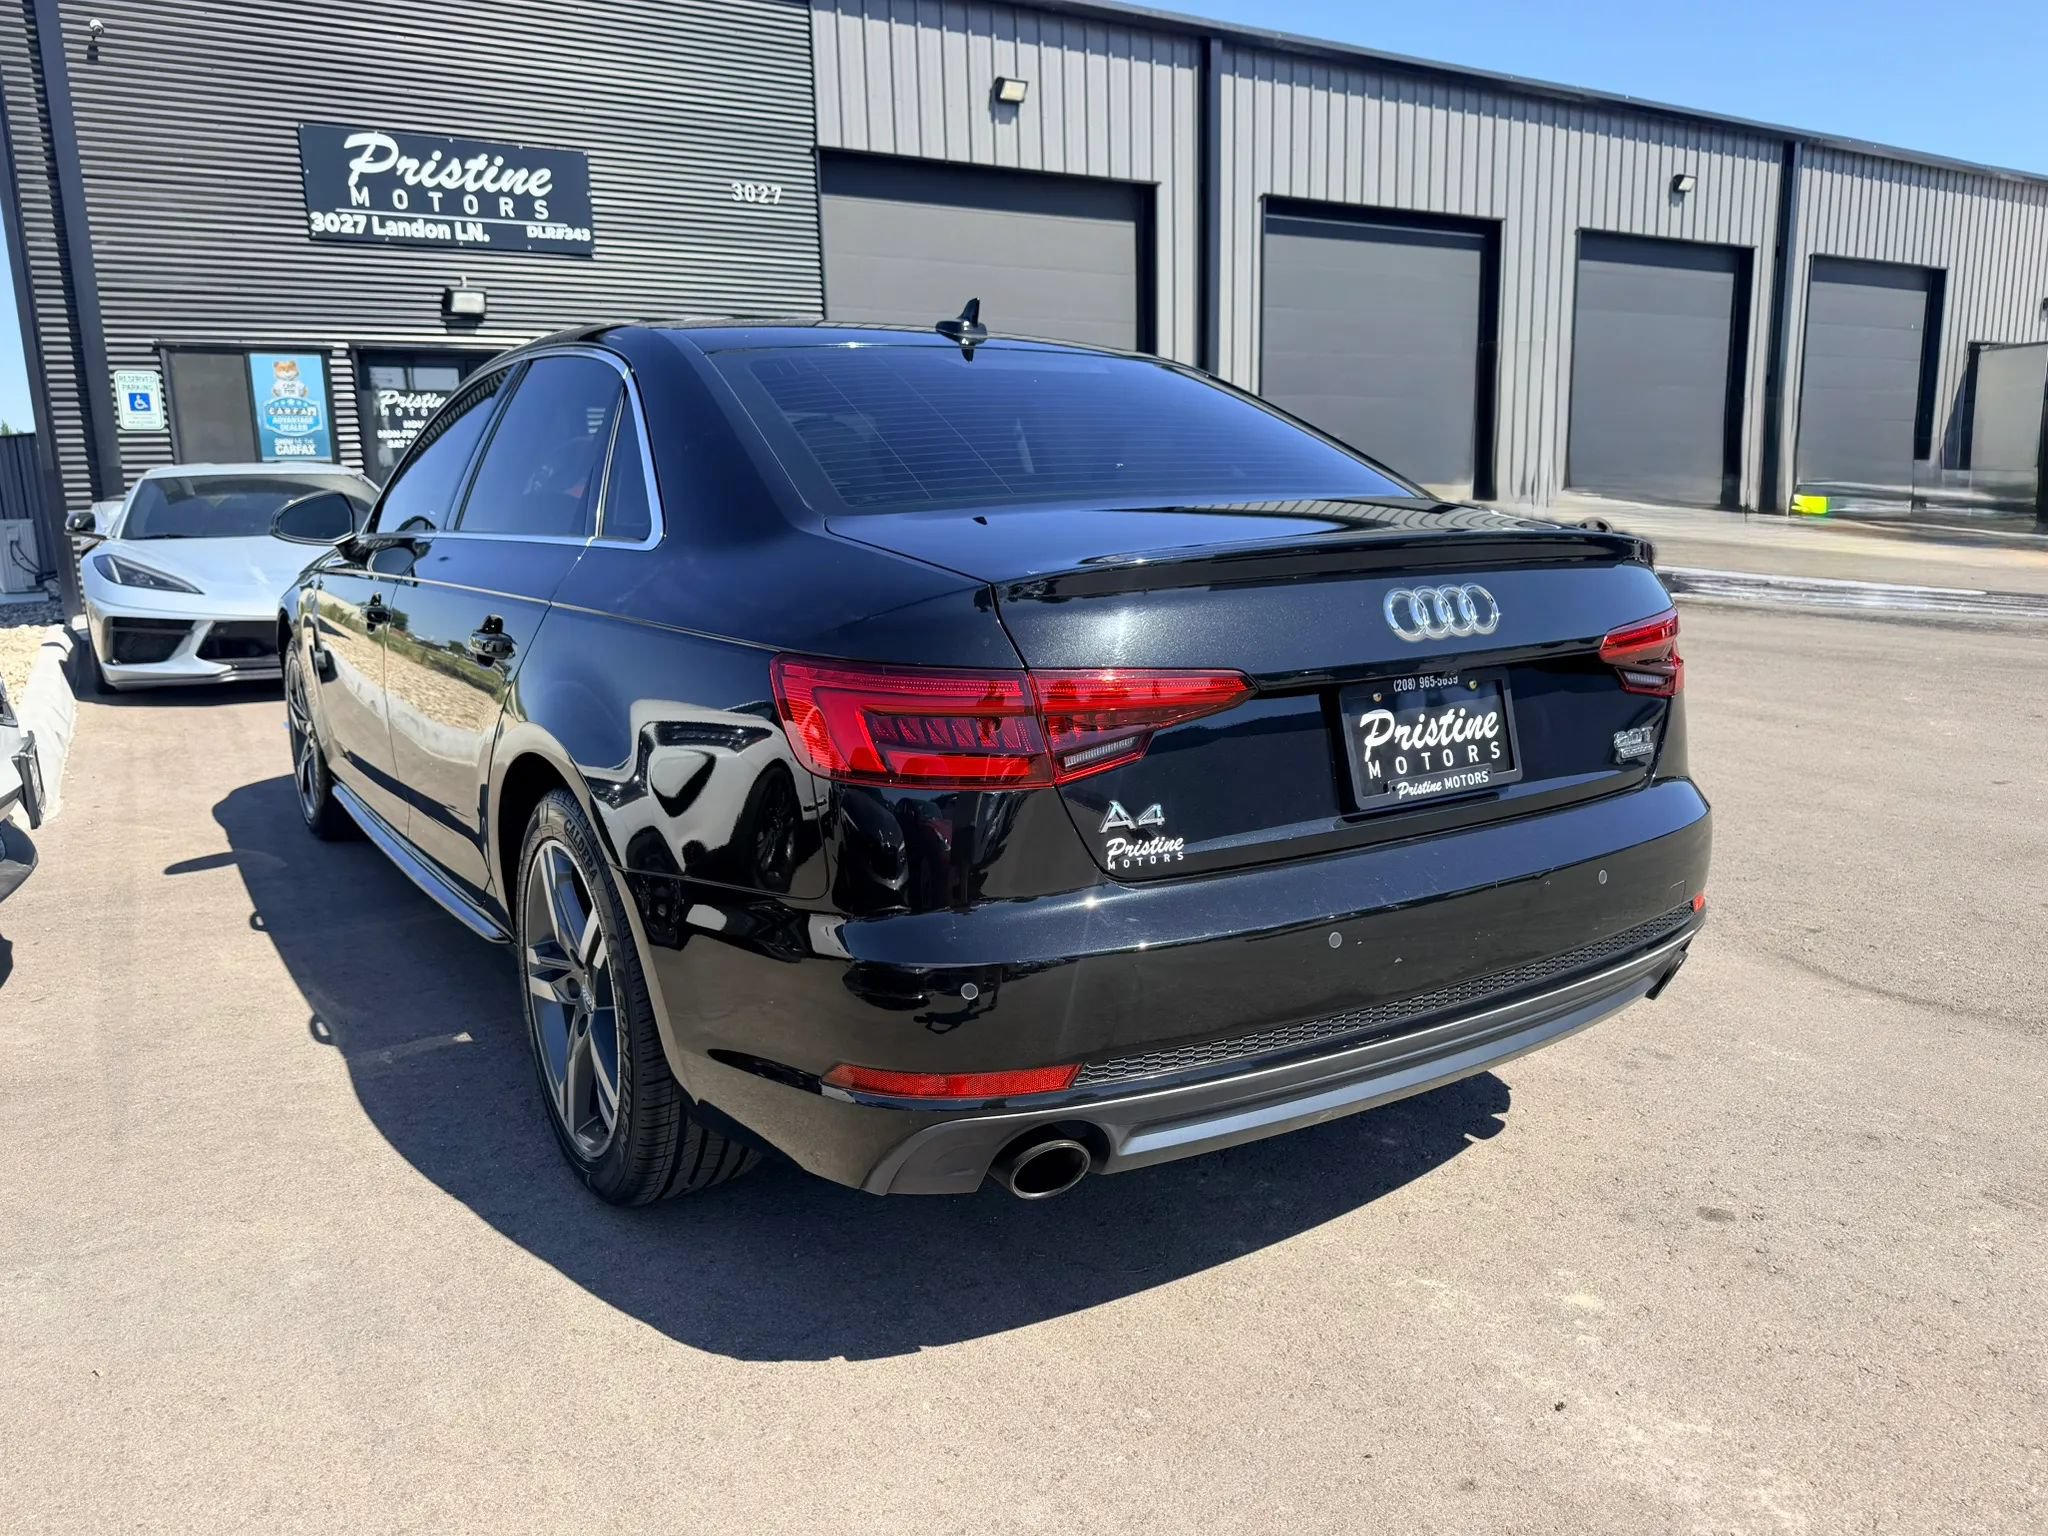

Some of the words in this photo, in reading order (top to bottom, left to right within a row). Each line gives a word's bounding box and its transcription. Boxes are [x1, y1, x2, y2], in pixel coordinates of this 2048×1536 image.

[344, 132, 553, 197] Pristine
[350, 187, 549, 220] MOTORS
[731, 182, 781, 204] 3027
[310, 211, 367, 234] 3027
[371, 215, 451, 240] Landon
[454, 221, 490, 242] LN.
[1393, 677, 1416, 693] (208)
[1360, 708, 1499, 762] Pristine
[1368, 741, 1501, 779] MOTORS
[1397, 779, 1442, 799] Pristine
[1444, 770, 1489, 790] MOTORS
[1098, 800, 1165, 834] A4
[564, 818, 598, 884] CALDERA
[1106, 836, 1184, 862] Pristine
[1107, 851, 1184, 870] MOTORS
